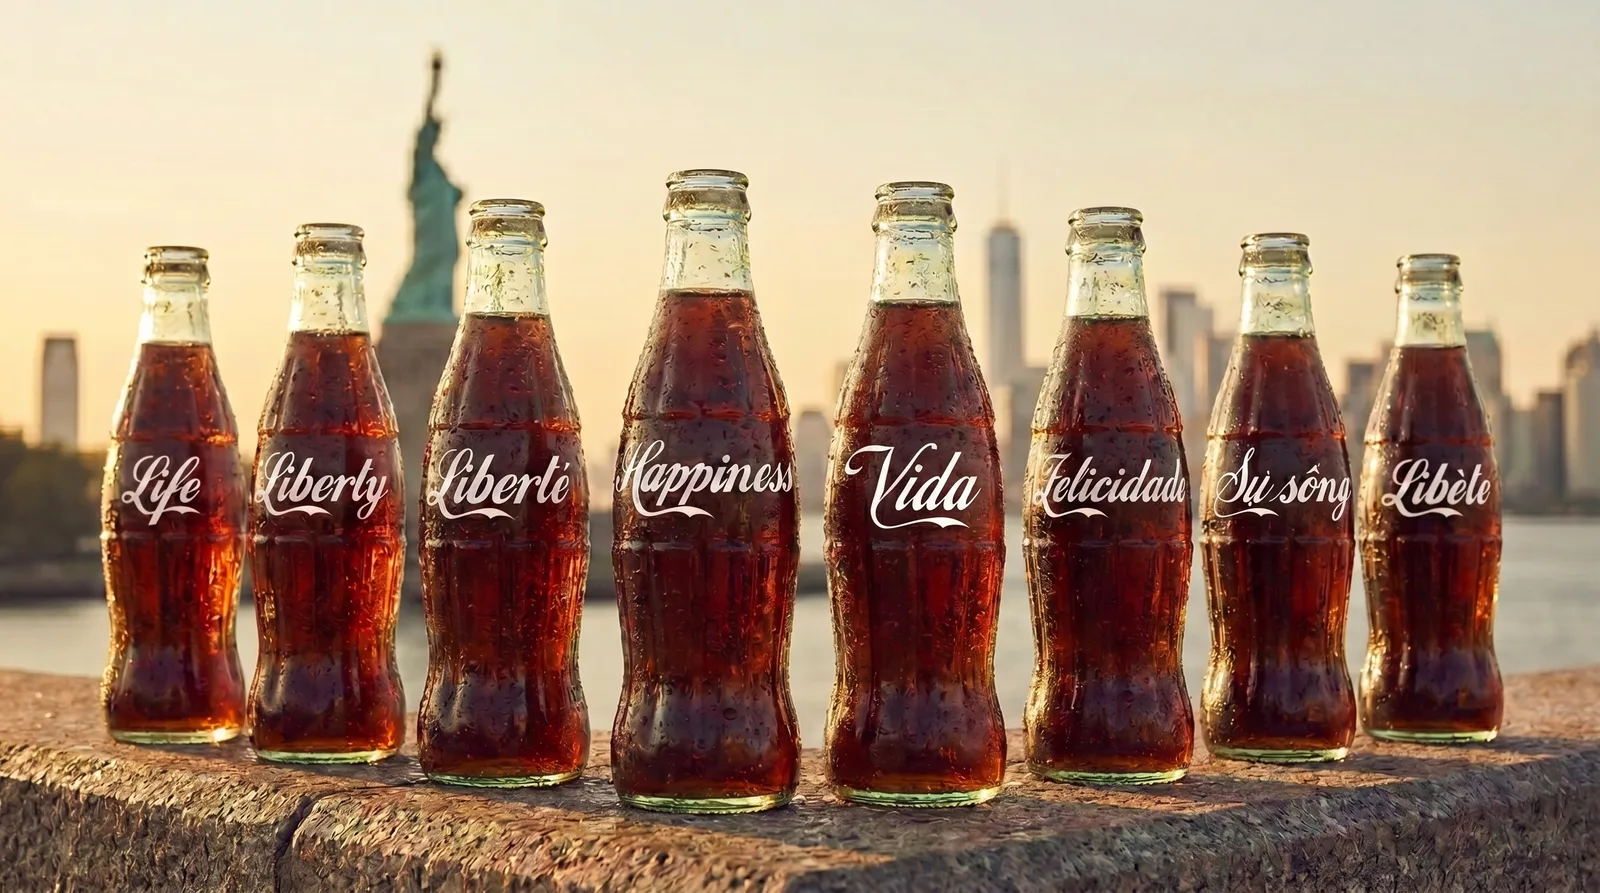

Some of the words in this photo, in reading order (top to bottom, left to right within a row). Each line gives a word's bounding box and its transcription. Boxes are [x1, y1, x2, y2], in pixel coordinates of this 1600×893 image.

[121, 455, 201, 525] Life
[254, 452, 389, 520] Liberty
[426, 448, 571, 519] Liberté
[615, 439, 793, 518] Happiness
[845, 443, 981, 528] Vida
[1033, 452, 1186, 518] Felicidade
[1381, 458, 1491, 517] Libète
